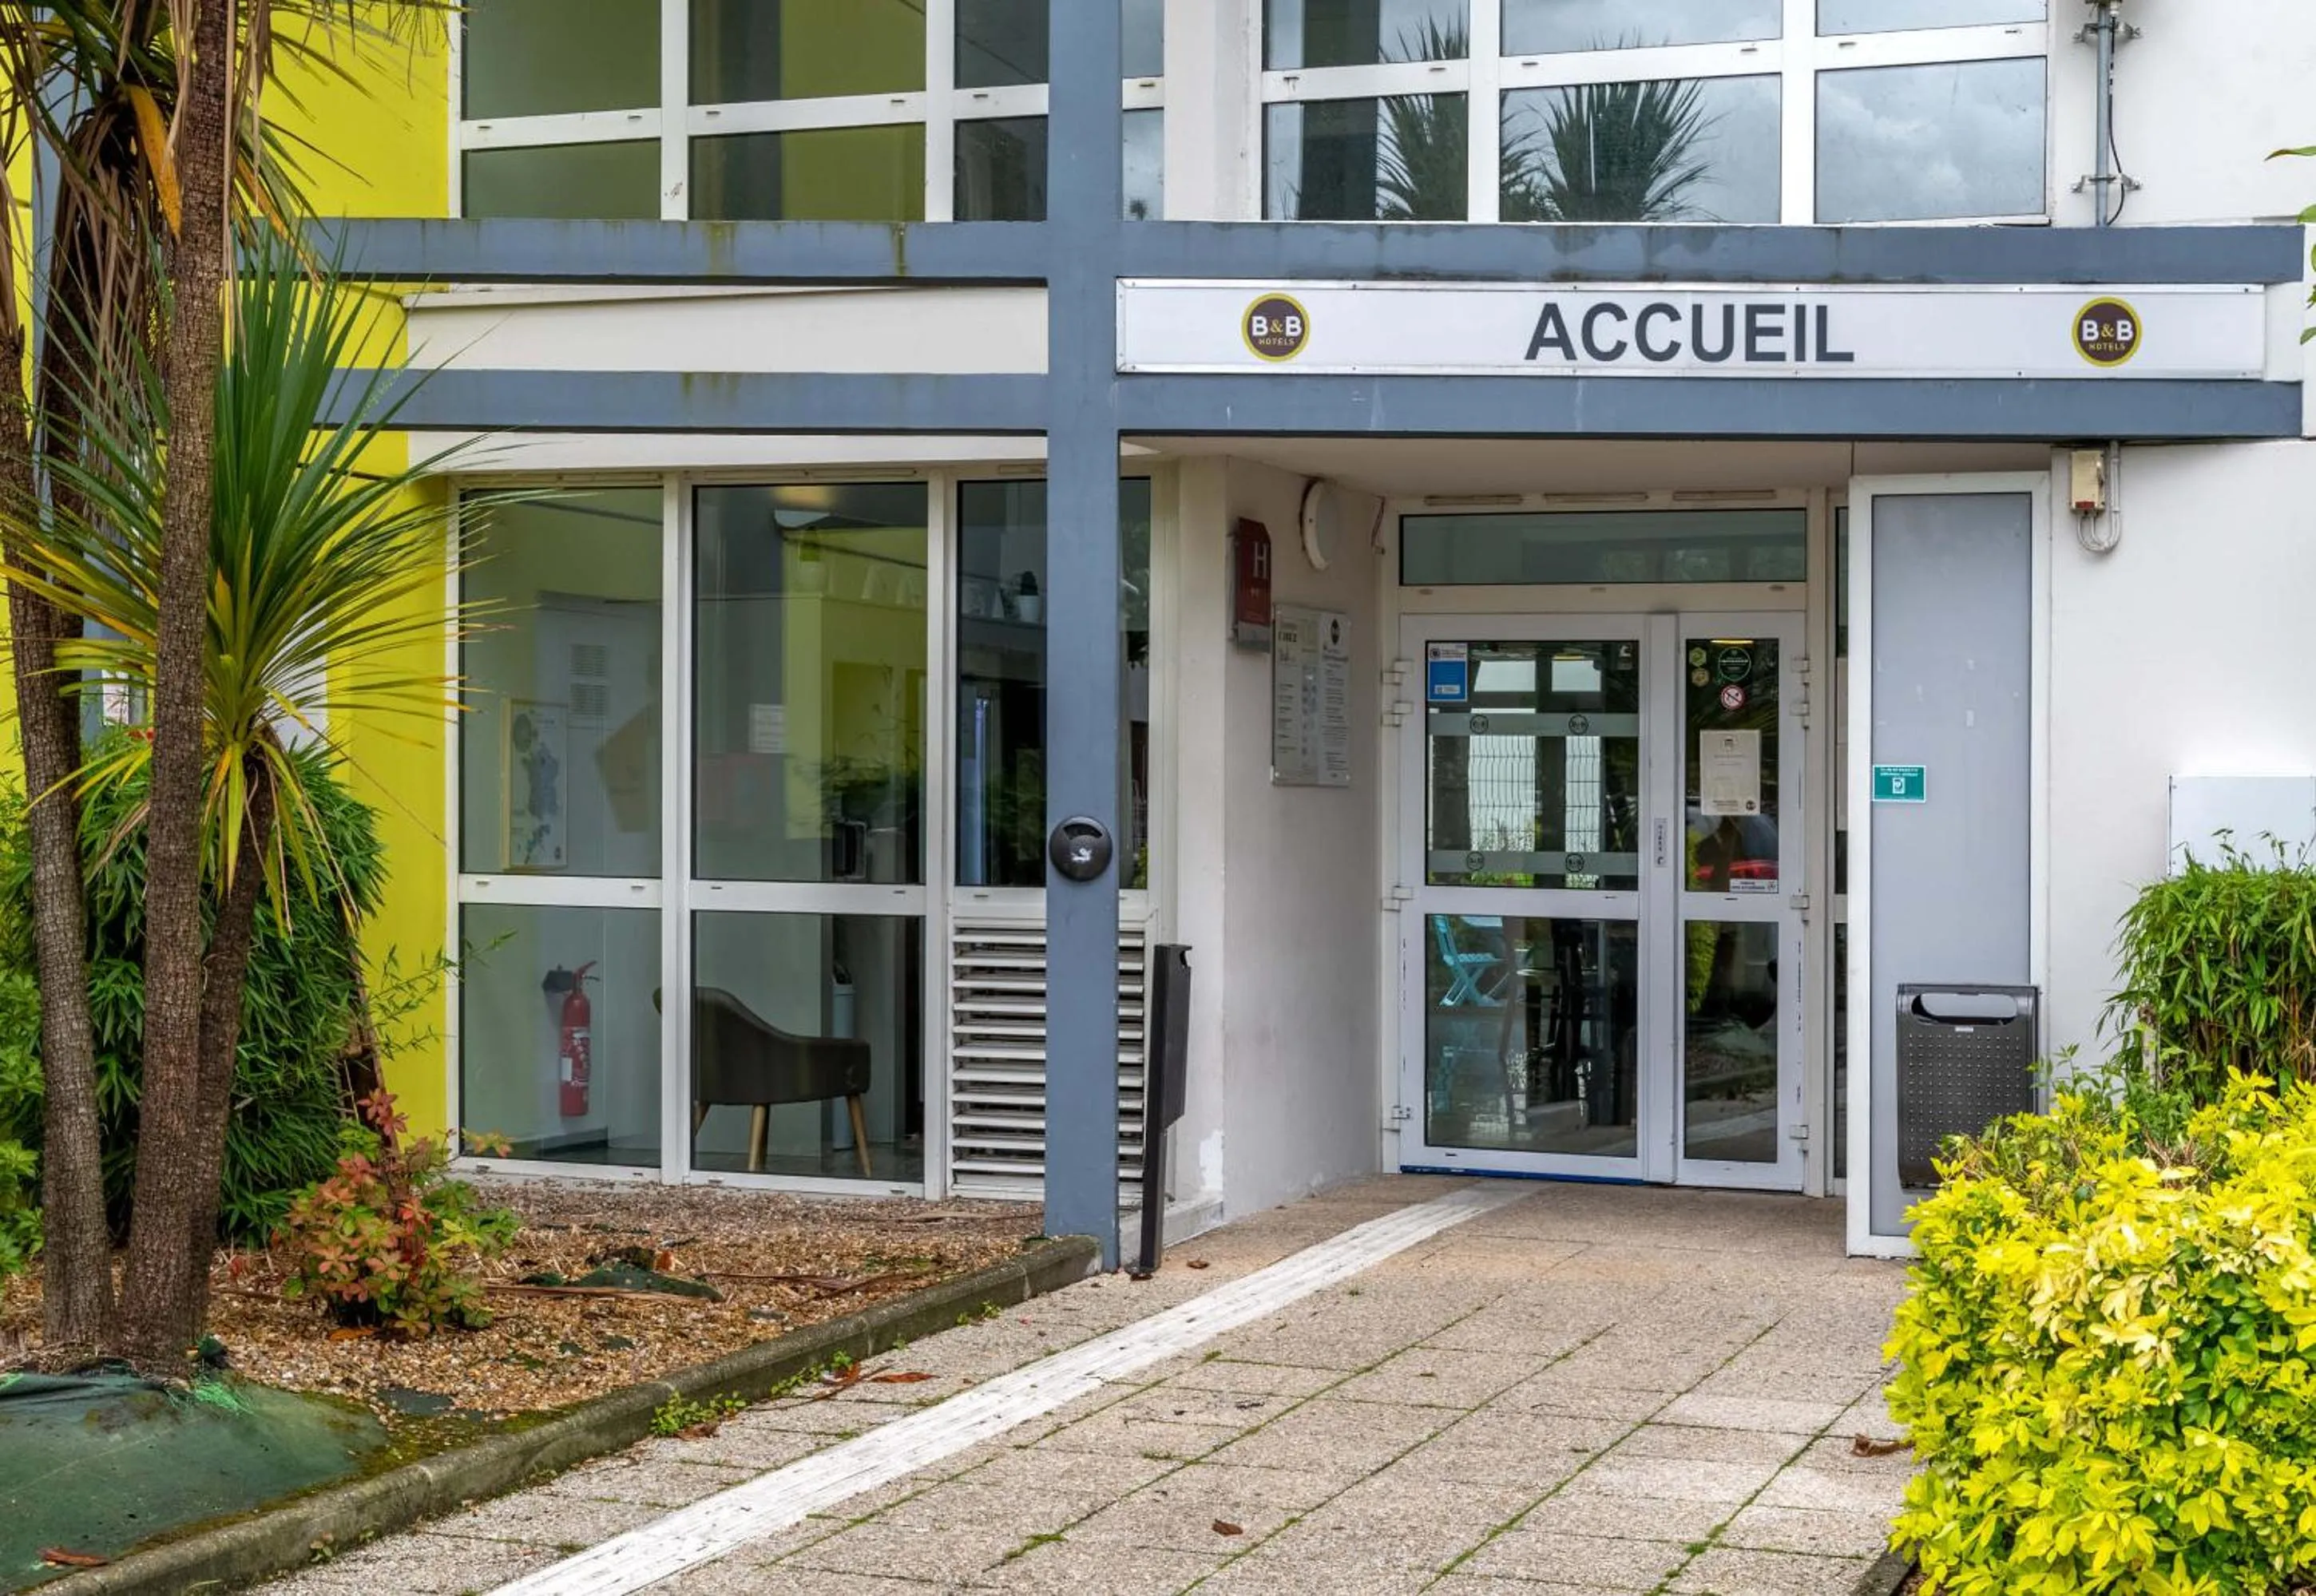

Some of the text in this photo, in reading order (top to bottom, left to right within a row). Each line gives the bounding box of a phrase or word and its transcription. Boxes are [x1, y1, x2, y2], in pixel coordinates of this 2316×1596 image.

[1251, 315, 1302, 336] B&B
[1524, 302, 1854, 362] ACCUEIL
[2082, 319, 2134, 341] B&B
[2088, 343, 2126, 351] HOTELS
[1253, 541, 1267, 580] H
